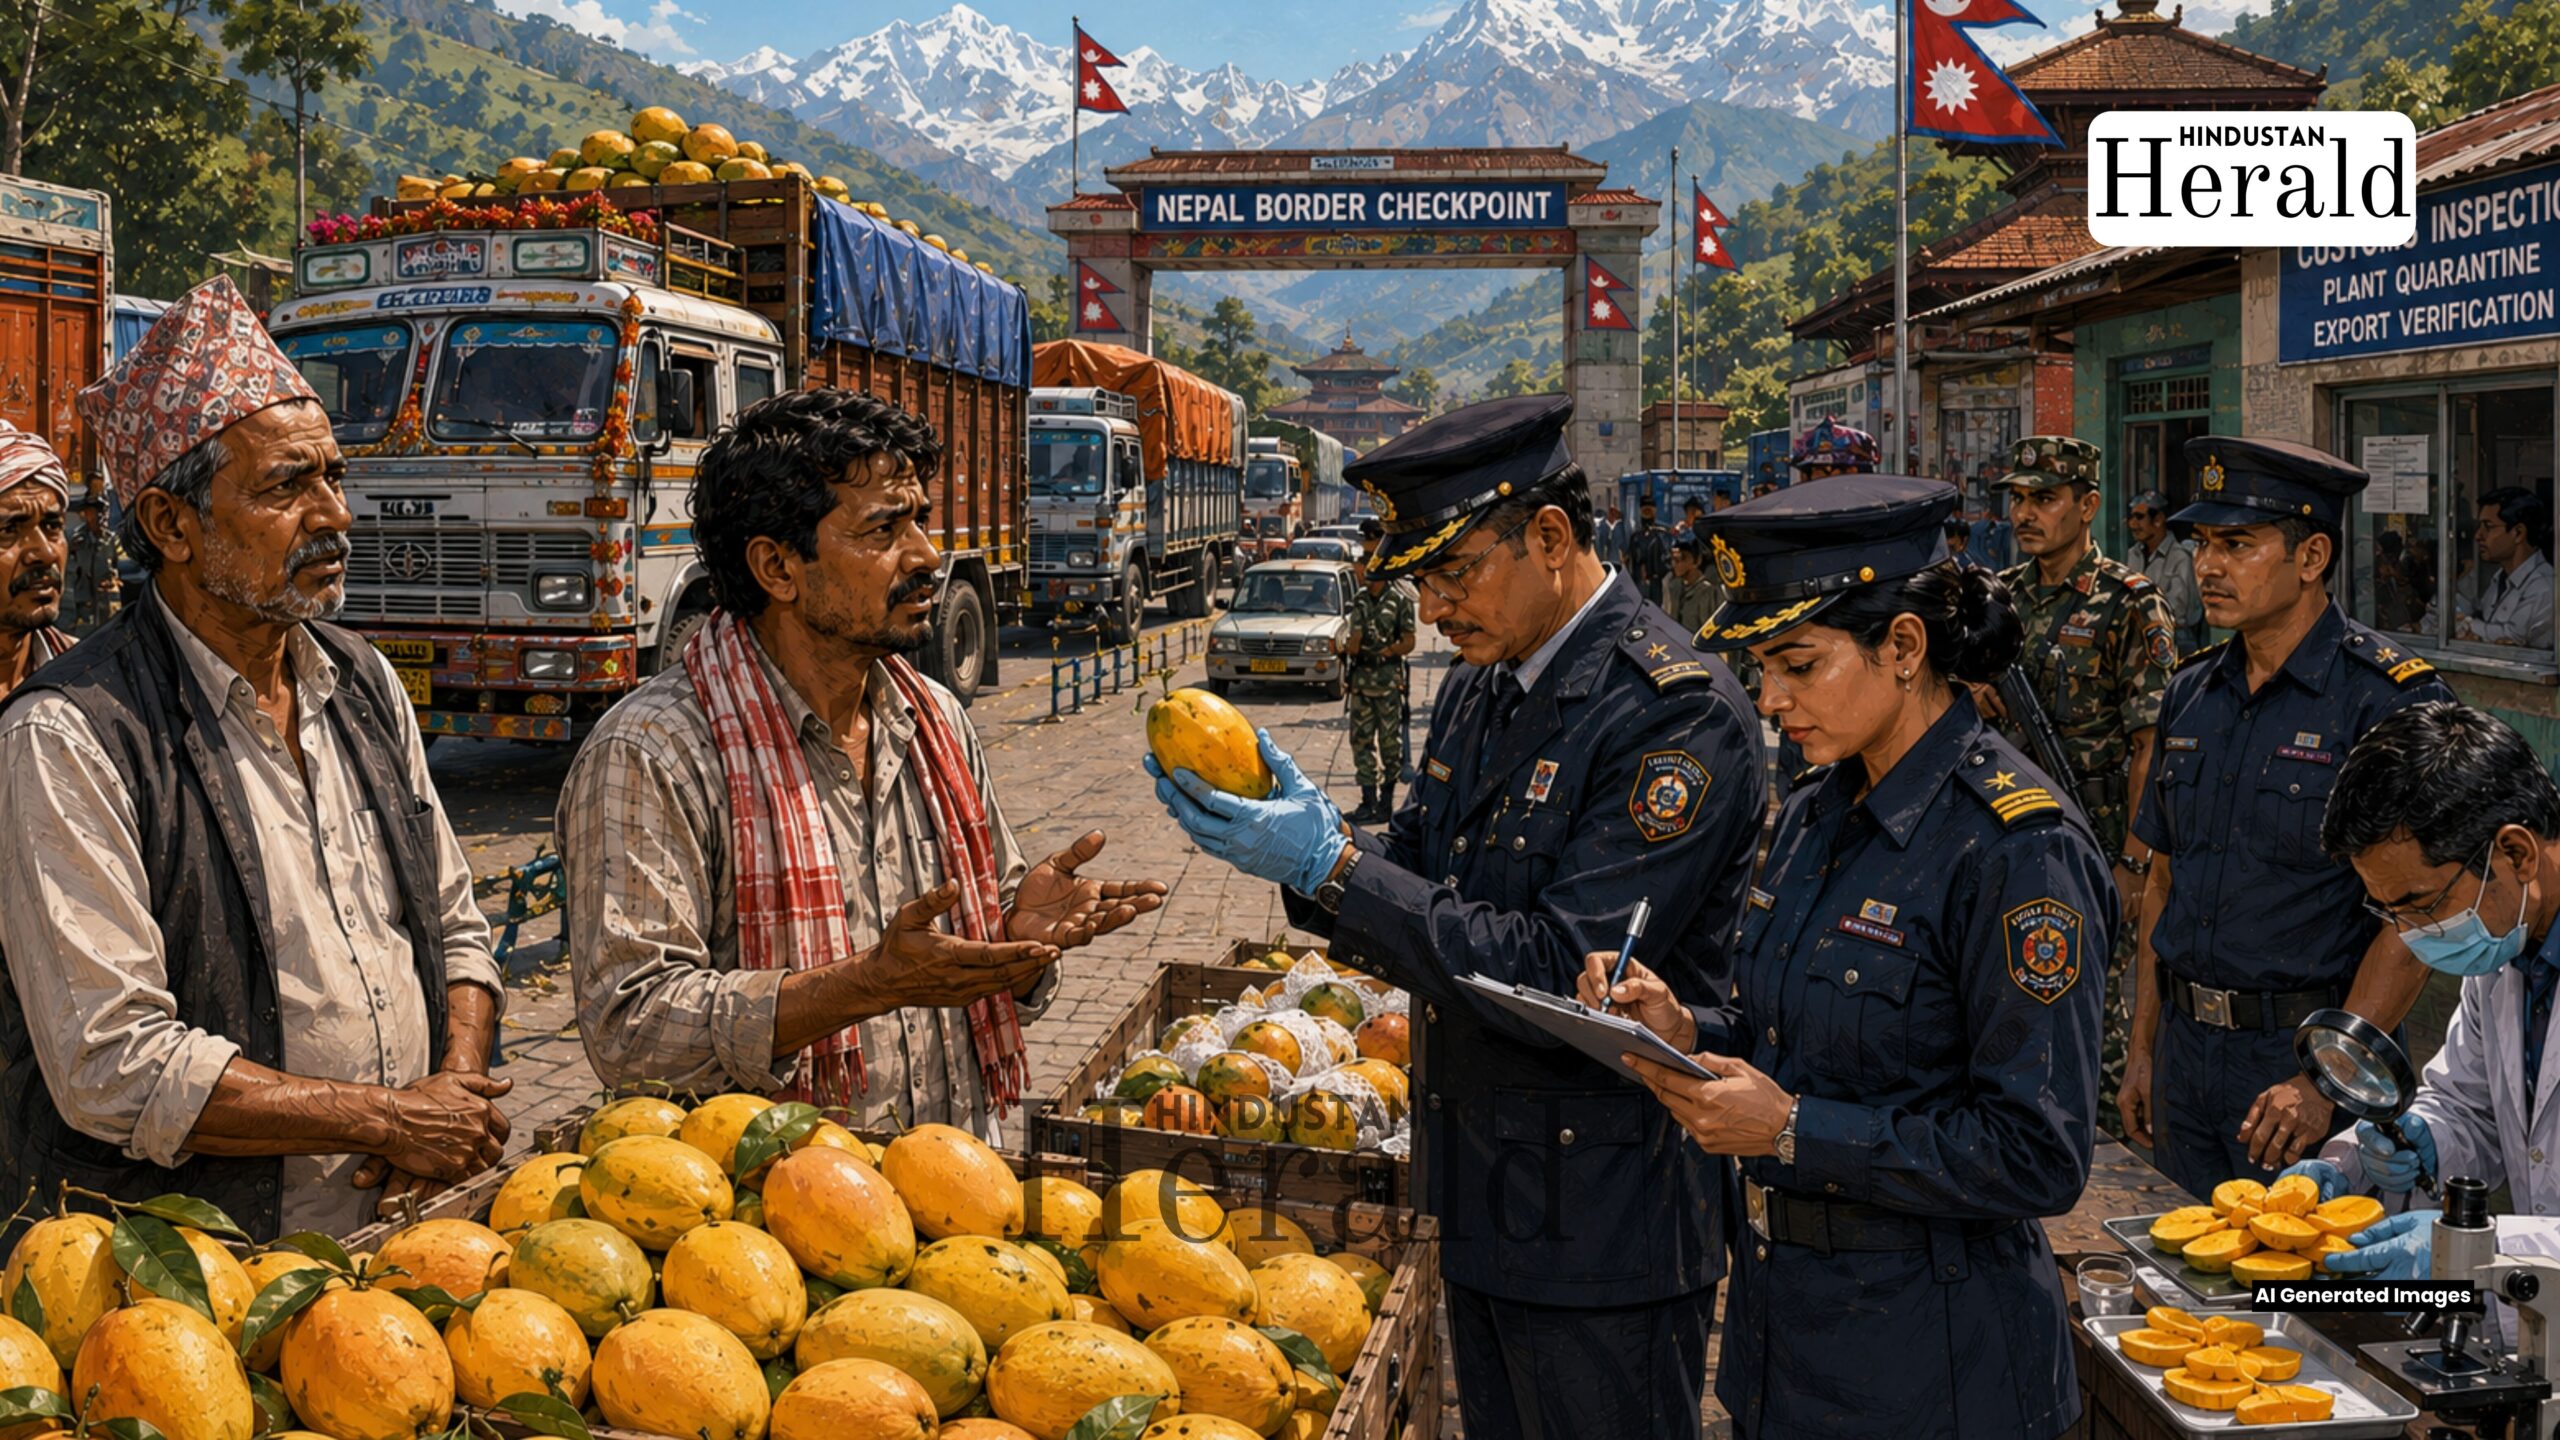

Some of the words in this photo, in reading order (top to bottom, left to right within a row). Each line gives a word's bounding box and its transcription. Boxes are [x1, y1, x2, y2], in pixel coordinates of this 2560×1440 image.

[1157, 193, 1244, 222] NEPAL
[1256, 192, 1366, 222] BORDER
[1377, 191, 1552, 221] CHECKPOINT
[2323, 269, 2387, 305] PLANT
[2395, 242, 2541, 295] QUARANTINE
[2314, 312, 2391, 347] EXPORT
[2399, 288, 2554, 336] VERIFICATION
